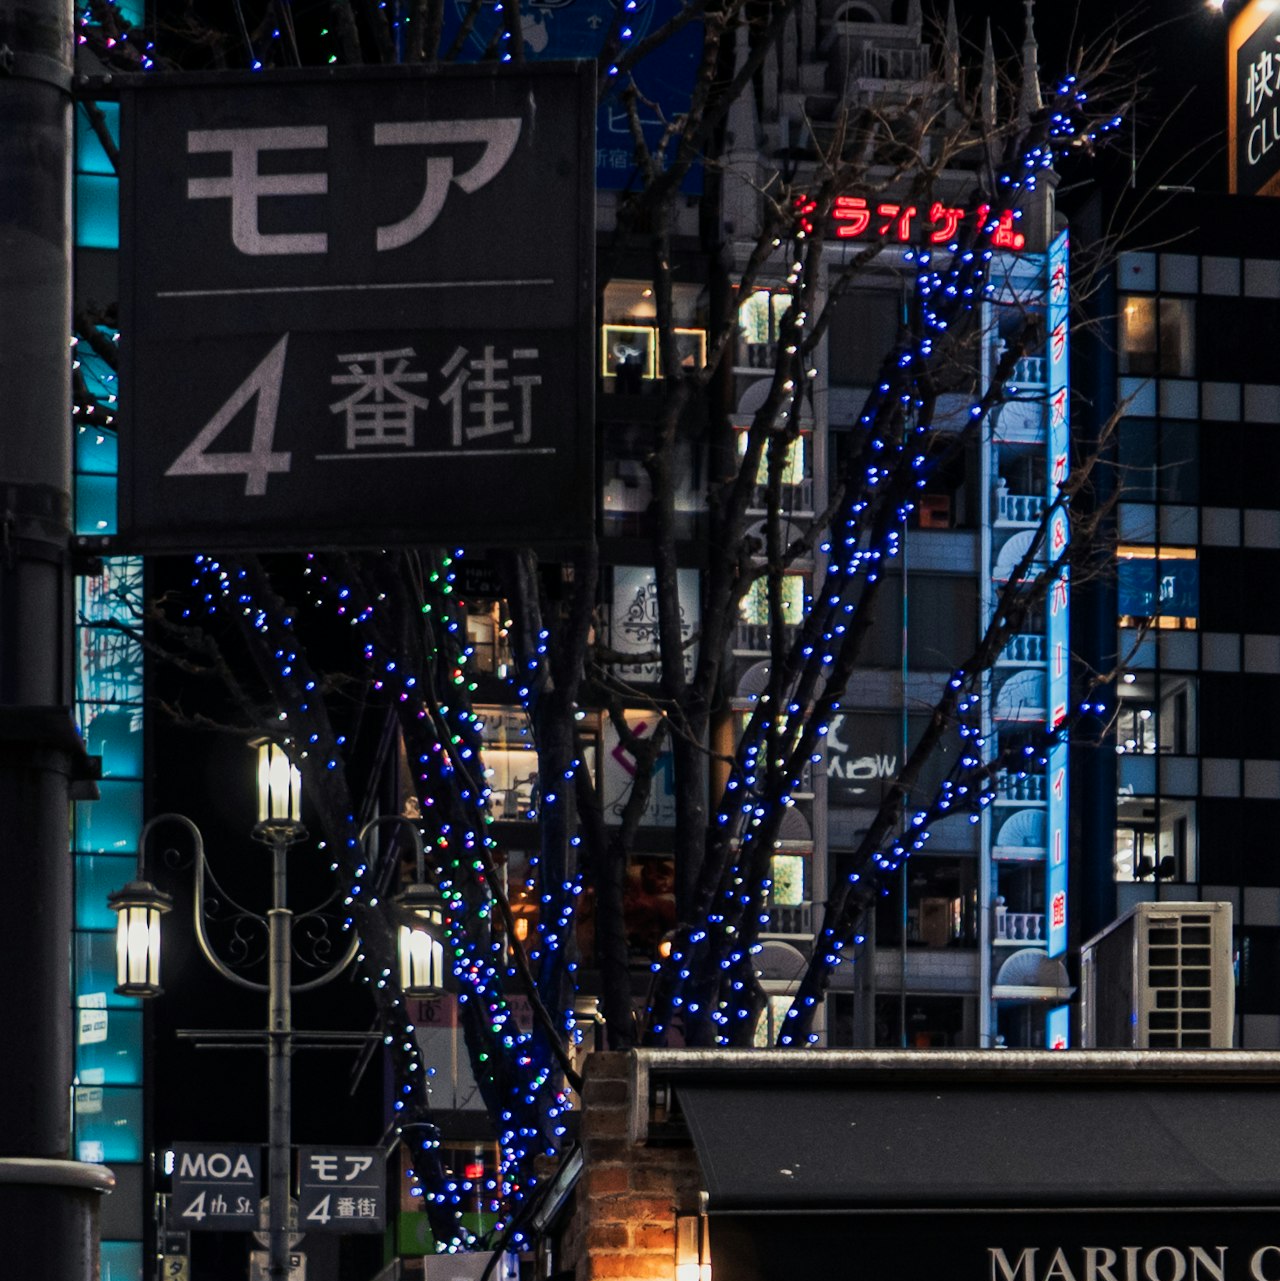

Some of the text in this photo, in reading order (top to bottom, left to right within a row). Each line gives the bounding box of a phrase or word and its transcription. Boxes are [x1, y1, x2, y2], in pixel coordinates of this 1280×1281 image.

[187, 117, 523, 256] モア
[180, 1152, 255, 1180] MOA
[309, 1154, 373, 1182] モア
[234, 1196, 254, 1214] St.
